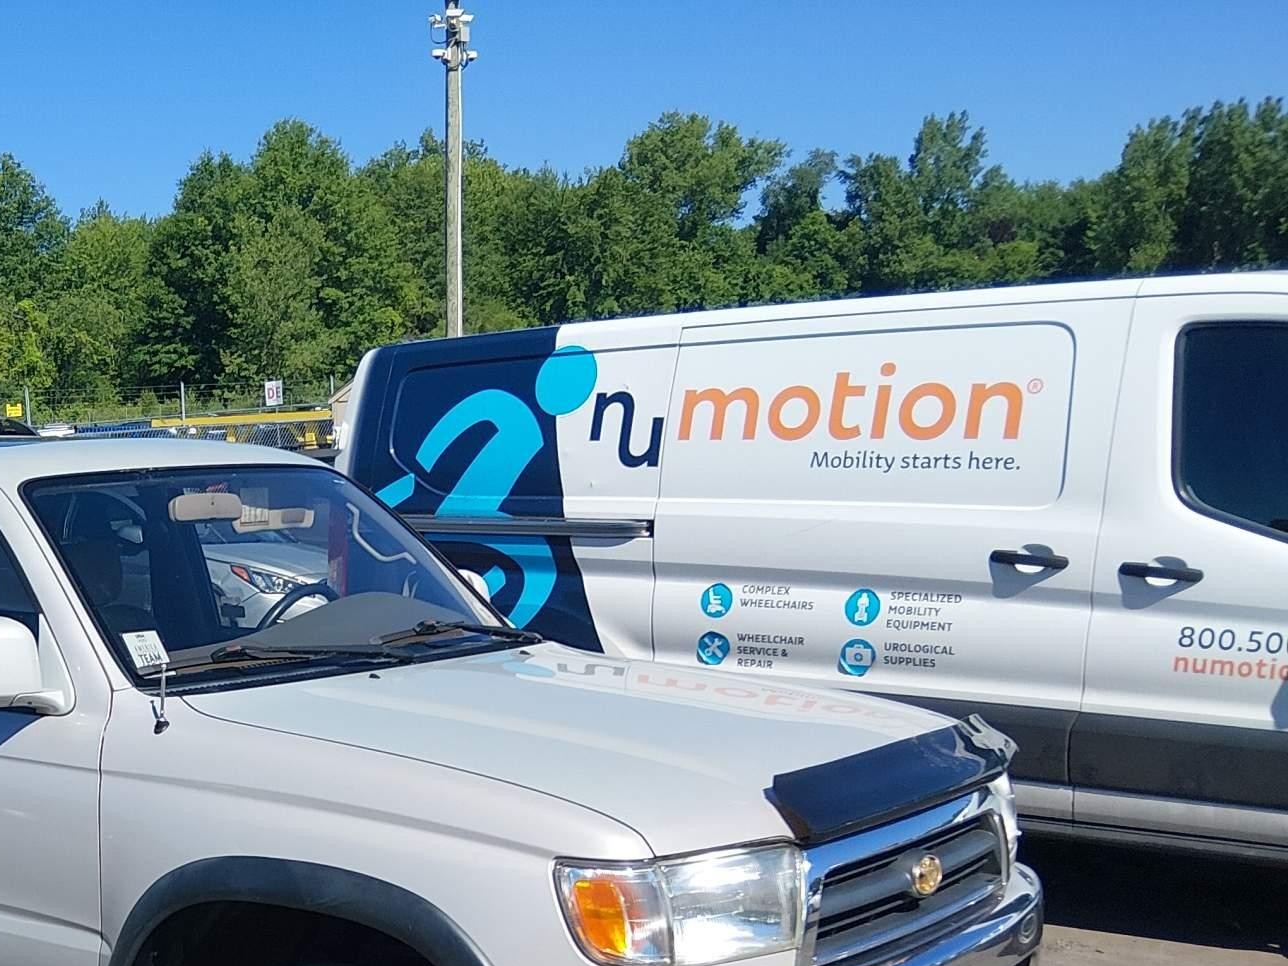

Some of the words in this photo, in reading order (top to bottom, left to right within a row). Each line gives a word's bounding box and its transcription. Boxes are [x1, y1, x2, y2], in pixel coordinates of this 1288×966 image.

[810, 450, 895, 473] Mobility
[900, 451, 962, 470] starts
[968, 451, 1021, 470] here.
[742, 584, 791, 596] COMPLEX
[890, 591, 962, 604] SPECIALIZED
[740, 598, 814, 611] WHEELCHAIRS
[888, 605, 941, 617] MOBILITY
[886, 619, 953, 632] EQUIPMENT
[737, 633, 805, 646] WHEELCHAIR
[1178, 626, 1288, 656] 800.50
[737, 646, 780, 657] SERVICE
[781, 649, 789, 658] &
[884, 642, 956, 656] UROLOGICAL
[138, 651, 162, 666] TEAM
[737, 658, 773, 670] REPAIR
[883, 655, 936, 668] SUPPLIES
